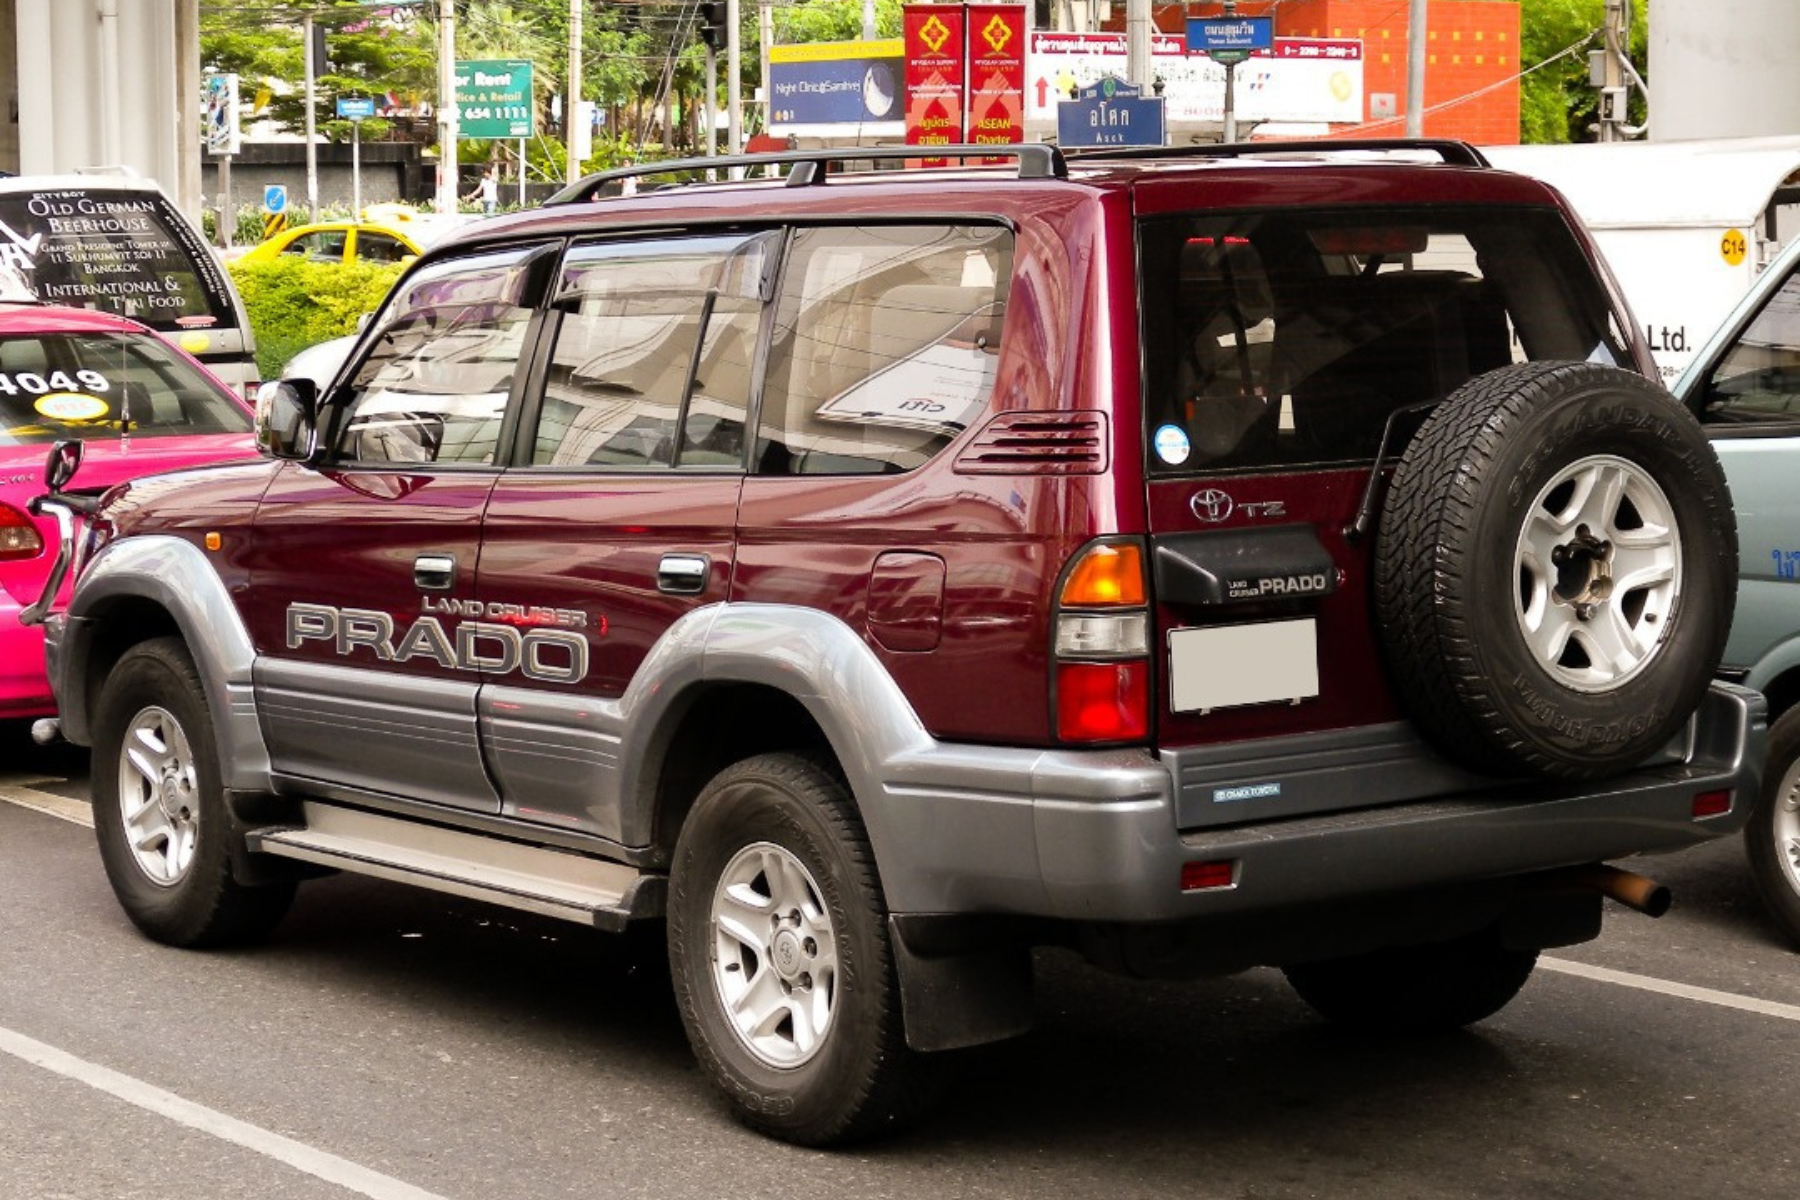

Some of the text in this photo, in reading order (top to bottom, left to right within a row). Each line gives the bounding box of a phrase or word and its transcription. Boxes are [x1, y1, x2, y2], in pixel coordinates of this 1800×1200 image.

[475, 71, 512, 86] Rent
[490, 91, 522, 102] Retail
[776, 82, 796, 96] Night
[465, 107, 490, 119] 654
[495, 106, 527, 119] 1111
[977, 118, 1011, 129] ASEAN
[976, 134, 1011, 144] Charter
[77, 198, 156, 215] GERMAN
[48, 217, 150, 233] BEERHOUSE
[1721, 238, 1746, 256] C14
[164, 275, 181, 292] &
[1648, 324, 1691, 352] Ltd.
[1237, 500, 1287, 518] TZ
[1258, 573, 1326, 595] PRADO
[422, 595, 588, 628] LAND CRUISER
[286, 601, 590, 684] PRADO
